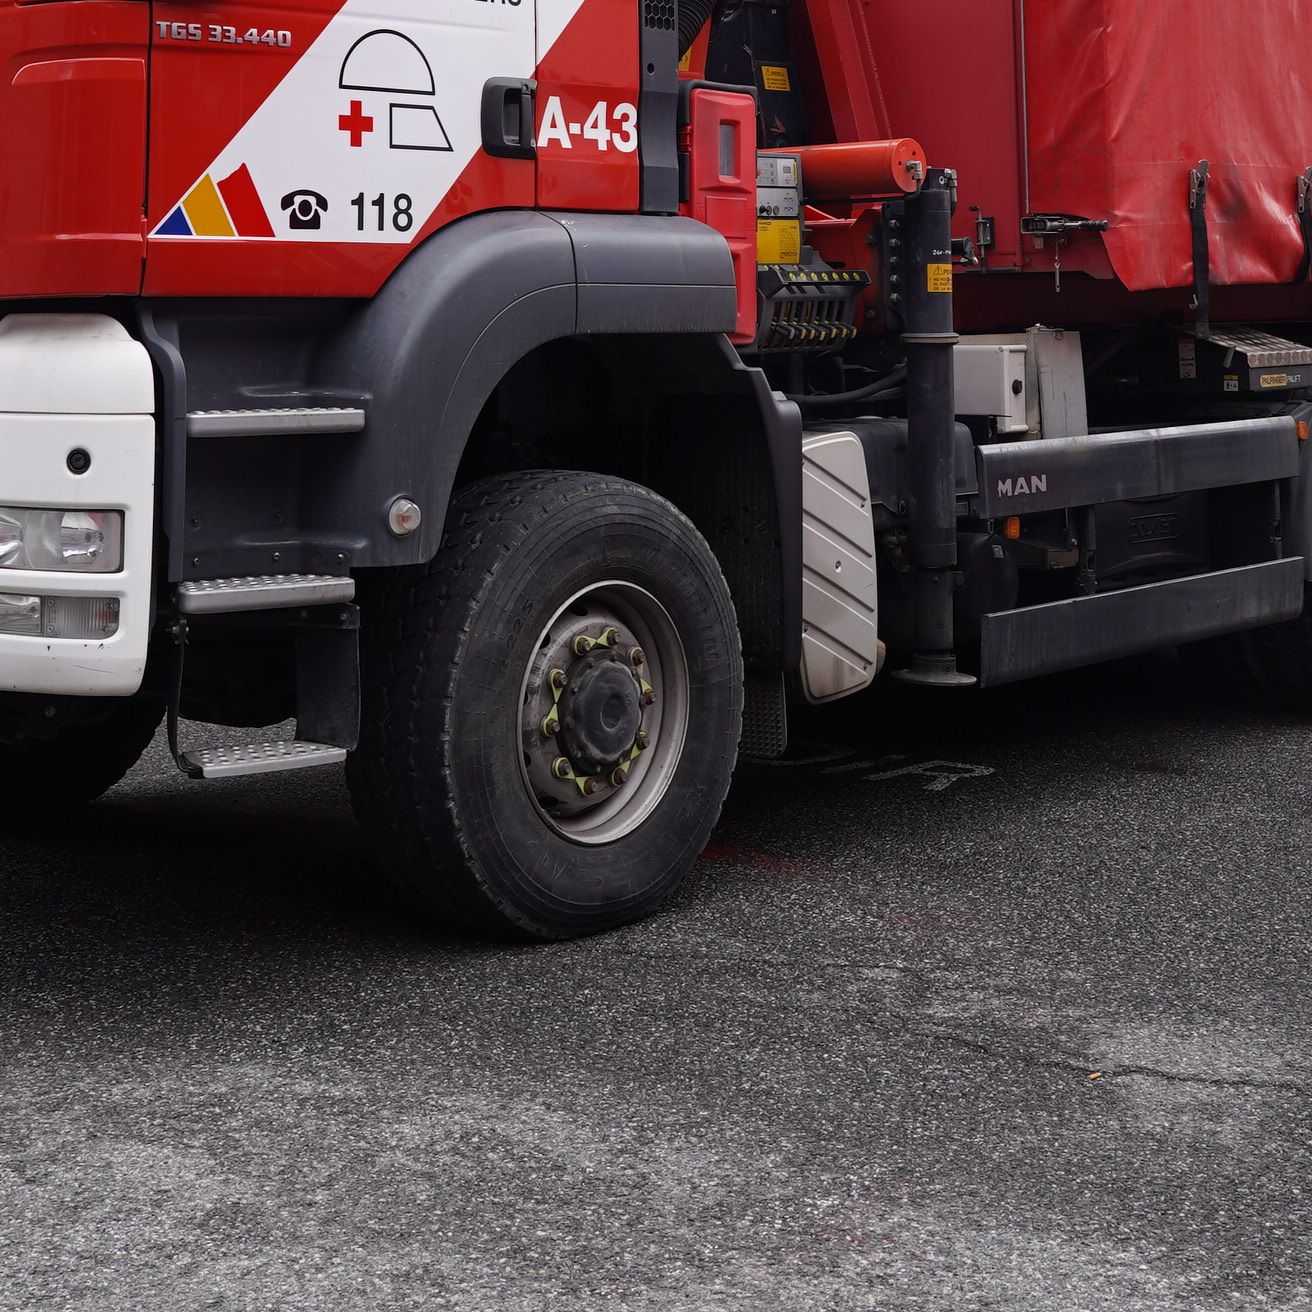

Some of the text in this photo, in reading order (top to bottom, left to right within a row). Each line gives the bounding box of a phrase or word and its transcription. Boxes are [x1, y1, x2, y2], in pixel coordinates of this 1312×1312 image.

[156, 21, 292, 48] TGS 33.440
[537, 96, 638, 153] A-43
[350, 192, 413, 232] 118
[997, 474, 1047, 497] MAN
